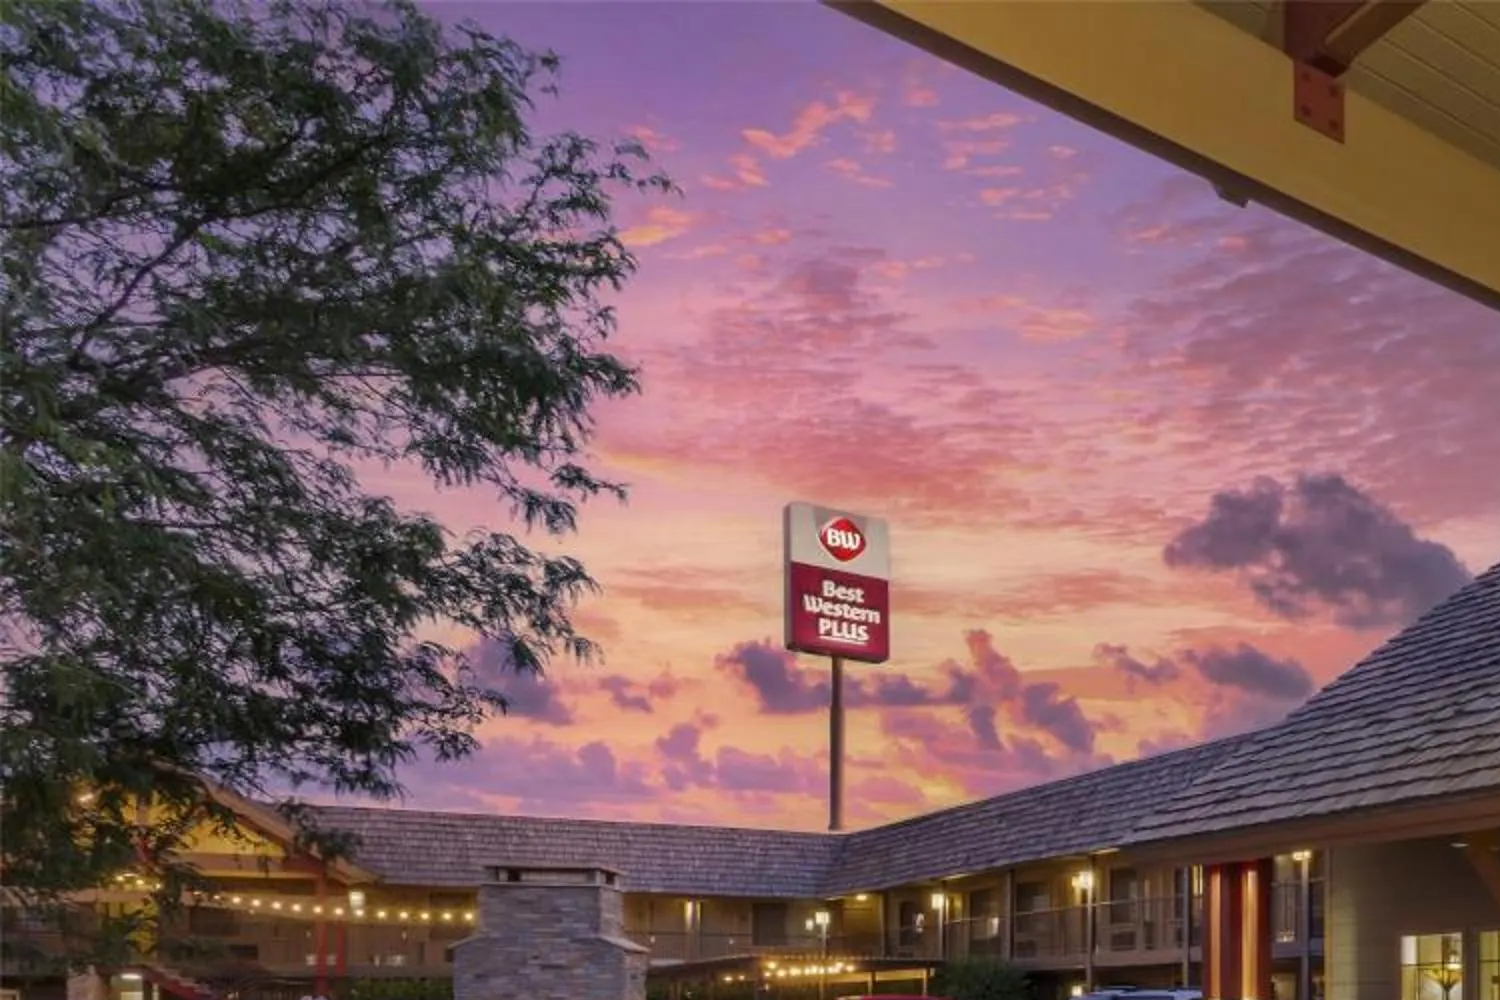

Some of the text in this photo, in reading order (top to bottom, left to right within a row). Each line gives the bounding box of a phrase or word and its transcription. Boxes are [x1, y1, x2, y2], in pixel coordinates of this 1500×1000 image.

[826, 527, 861, 550] BW
[821, 580, 865, 603] Best
[803, 595, 881, 624] Western
[818, 618, 869, 642] PLUS
